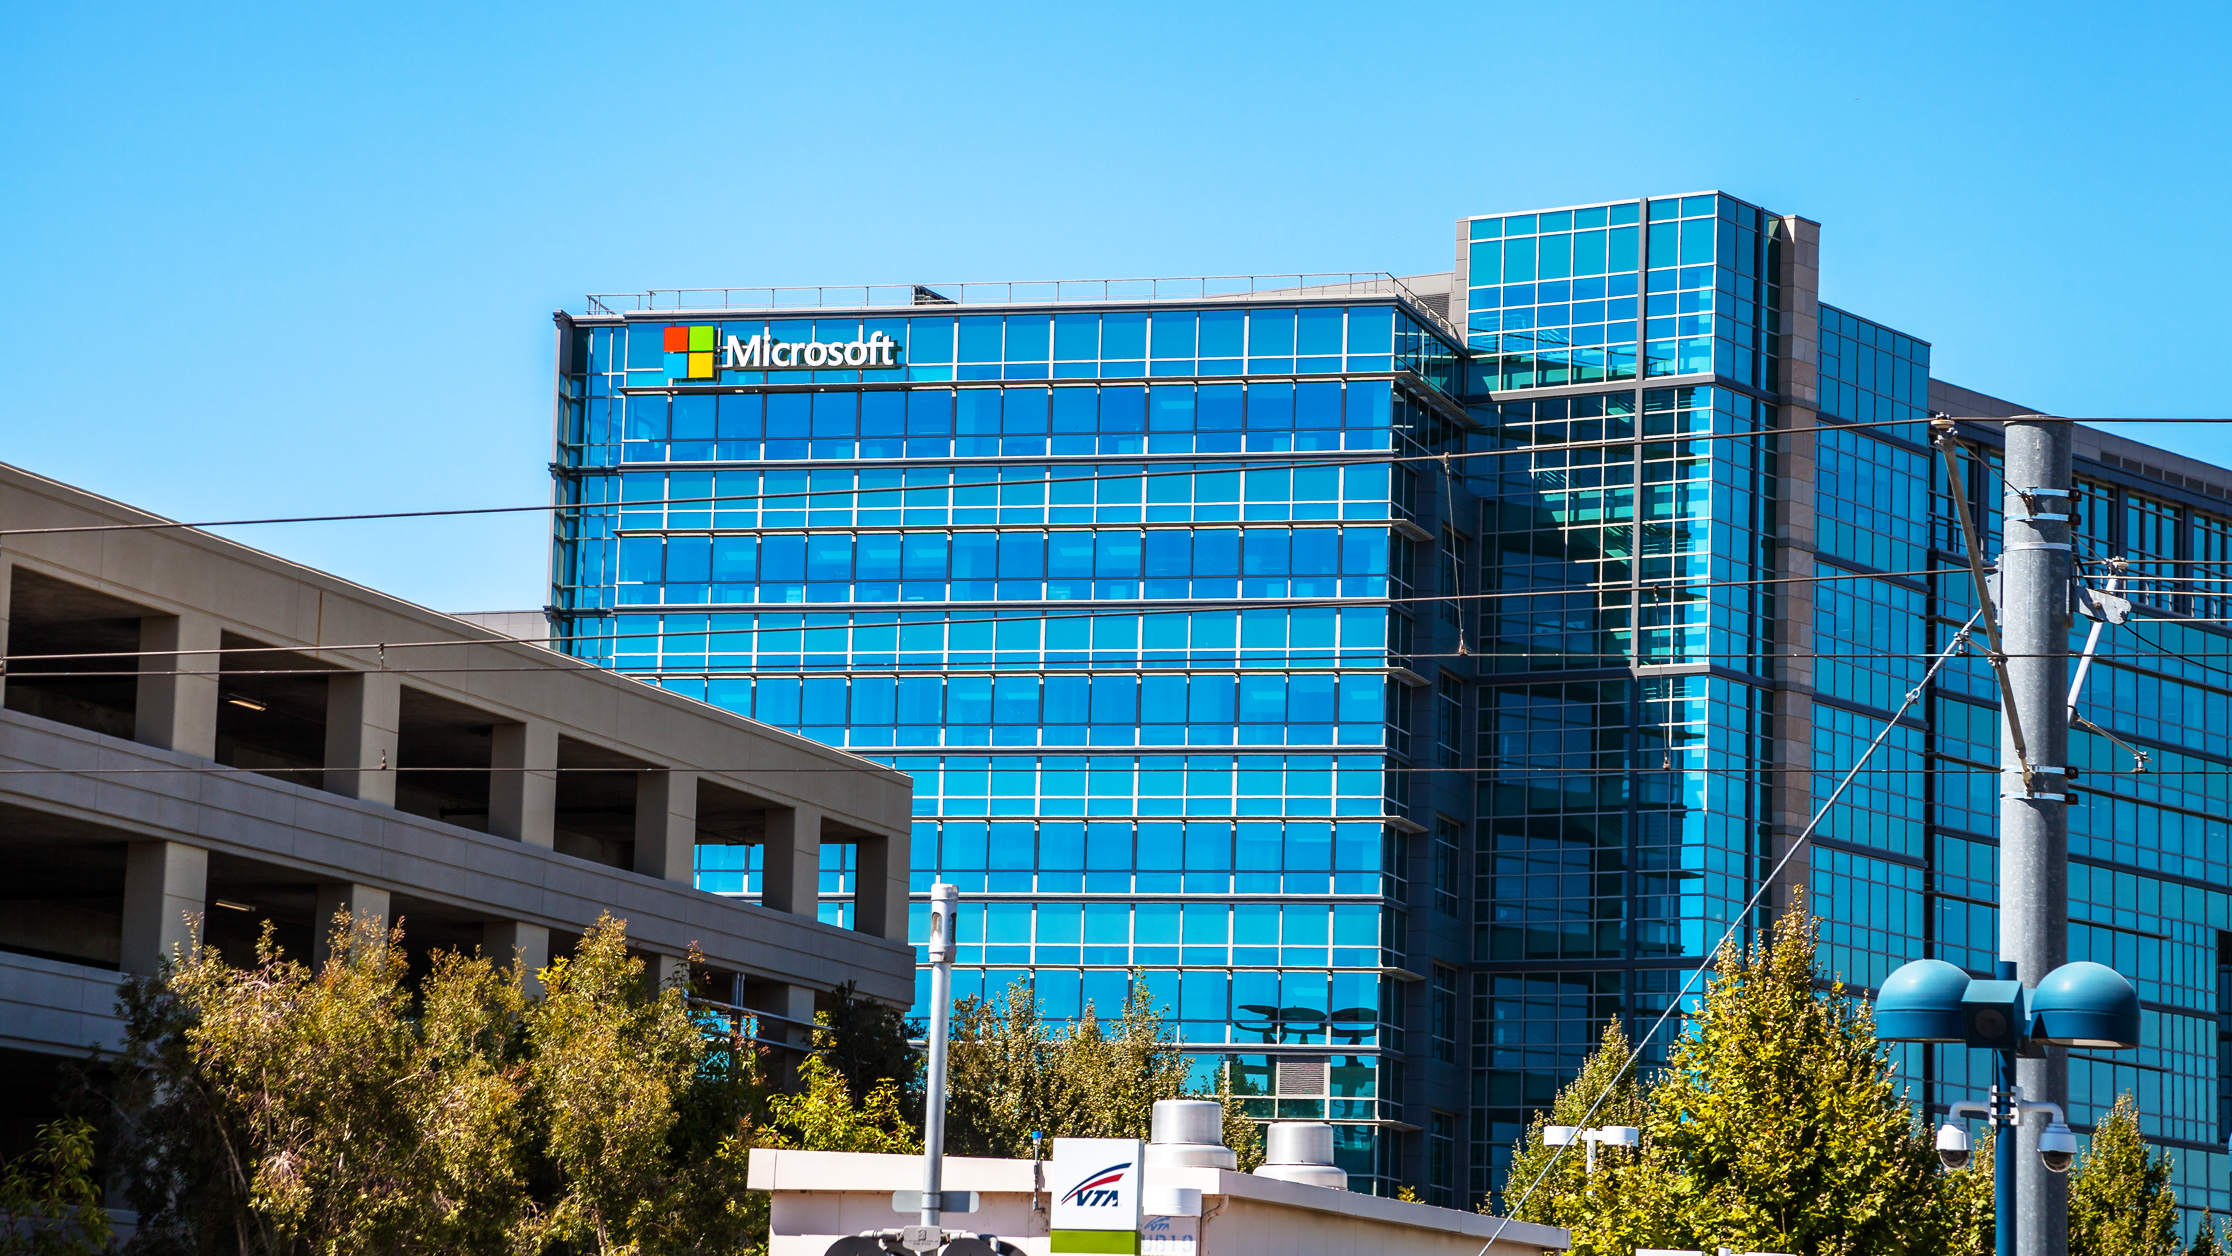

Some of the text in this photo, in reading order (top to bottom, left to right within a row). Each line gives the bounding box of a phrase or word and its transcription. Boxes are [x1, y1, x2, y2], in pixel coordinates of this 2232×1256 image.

[727, 331, 895, 367] Microsoft
[1077, 1190, 1119, 1207] VTA
[1150, 1223, 1170, 1231] VTA
